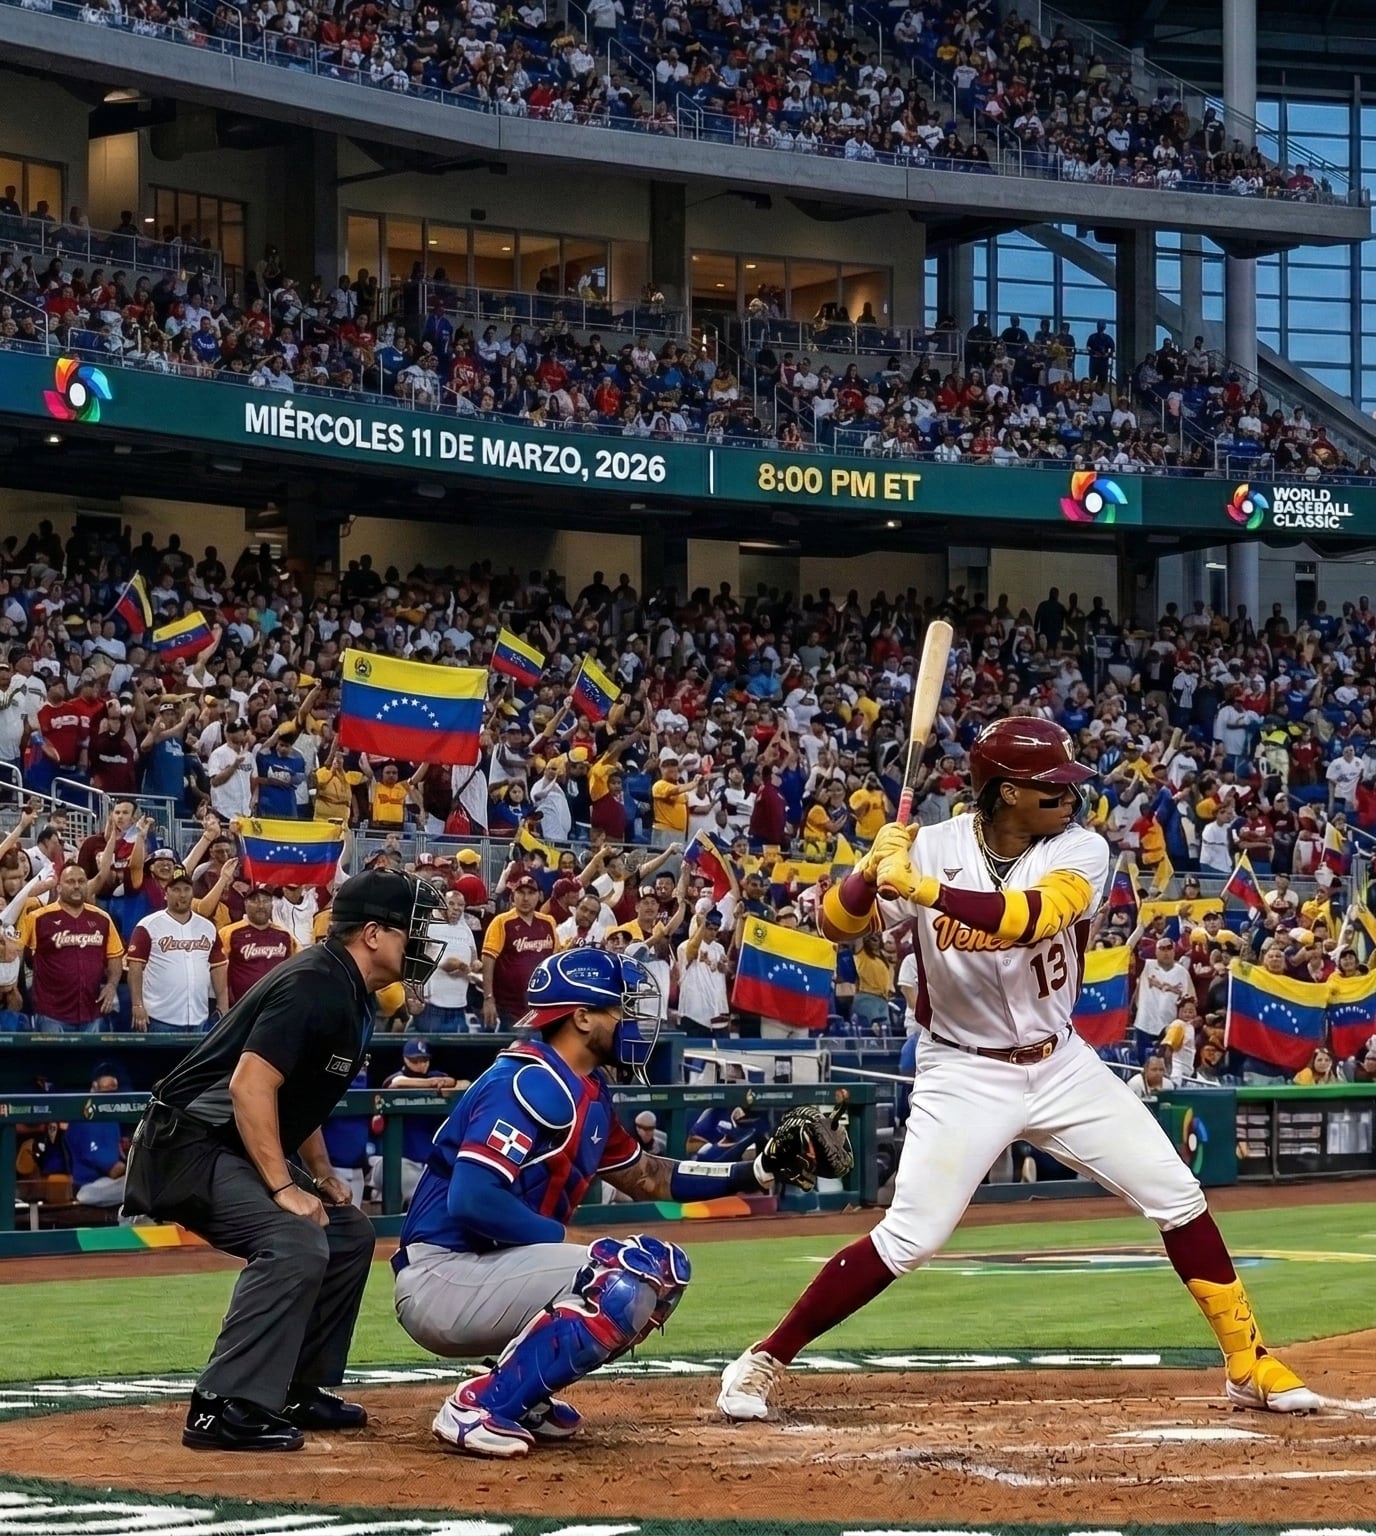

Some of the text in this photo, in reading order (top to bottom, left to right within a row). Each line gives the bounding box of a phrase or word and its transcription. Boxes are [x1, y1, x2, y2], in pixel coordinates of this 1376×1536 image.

[245, 400, 667, 483] MIÉRCOLES 11 DE MARZO, 2026
[758, 462, 922, 501] 8:00 PM ET
[1272, 487, 1354, 529] WORLD BASEBALL CLASSIC
[1029, 943, 1068, 999] 13
